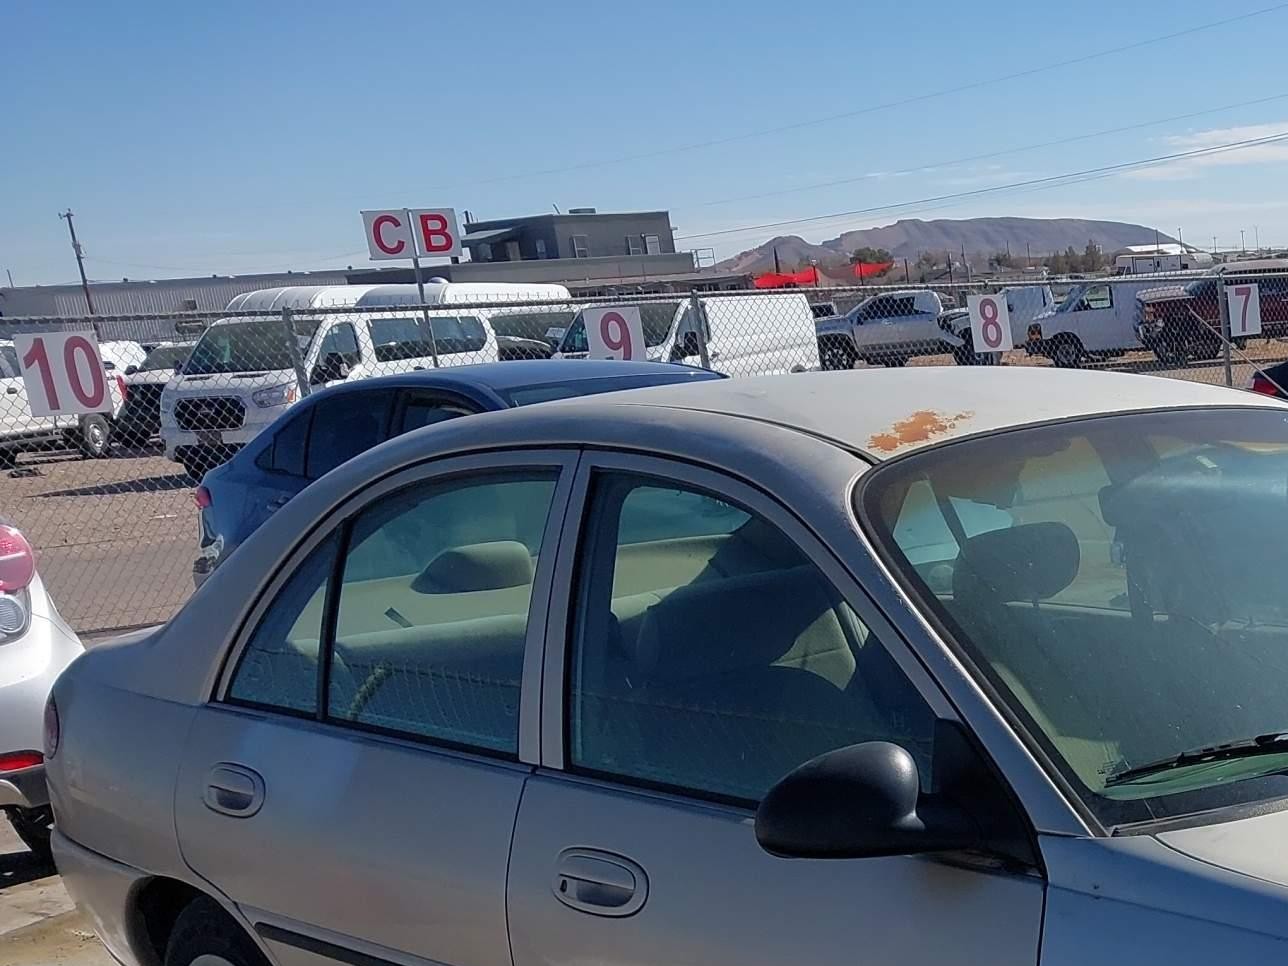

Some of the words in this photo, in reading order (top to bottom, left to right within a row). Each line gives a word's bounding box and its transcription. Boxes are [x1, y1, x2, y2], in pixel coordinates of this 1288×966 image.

[372, 214, 406, 256] C
[418, 213, 455, 254] B
[979, 298, 1003, 348] 8
[1234, 287, 1252, 332] 7
[600, 311, 632, 360] 9
[23, 335, 105, 410] 10
